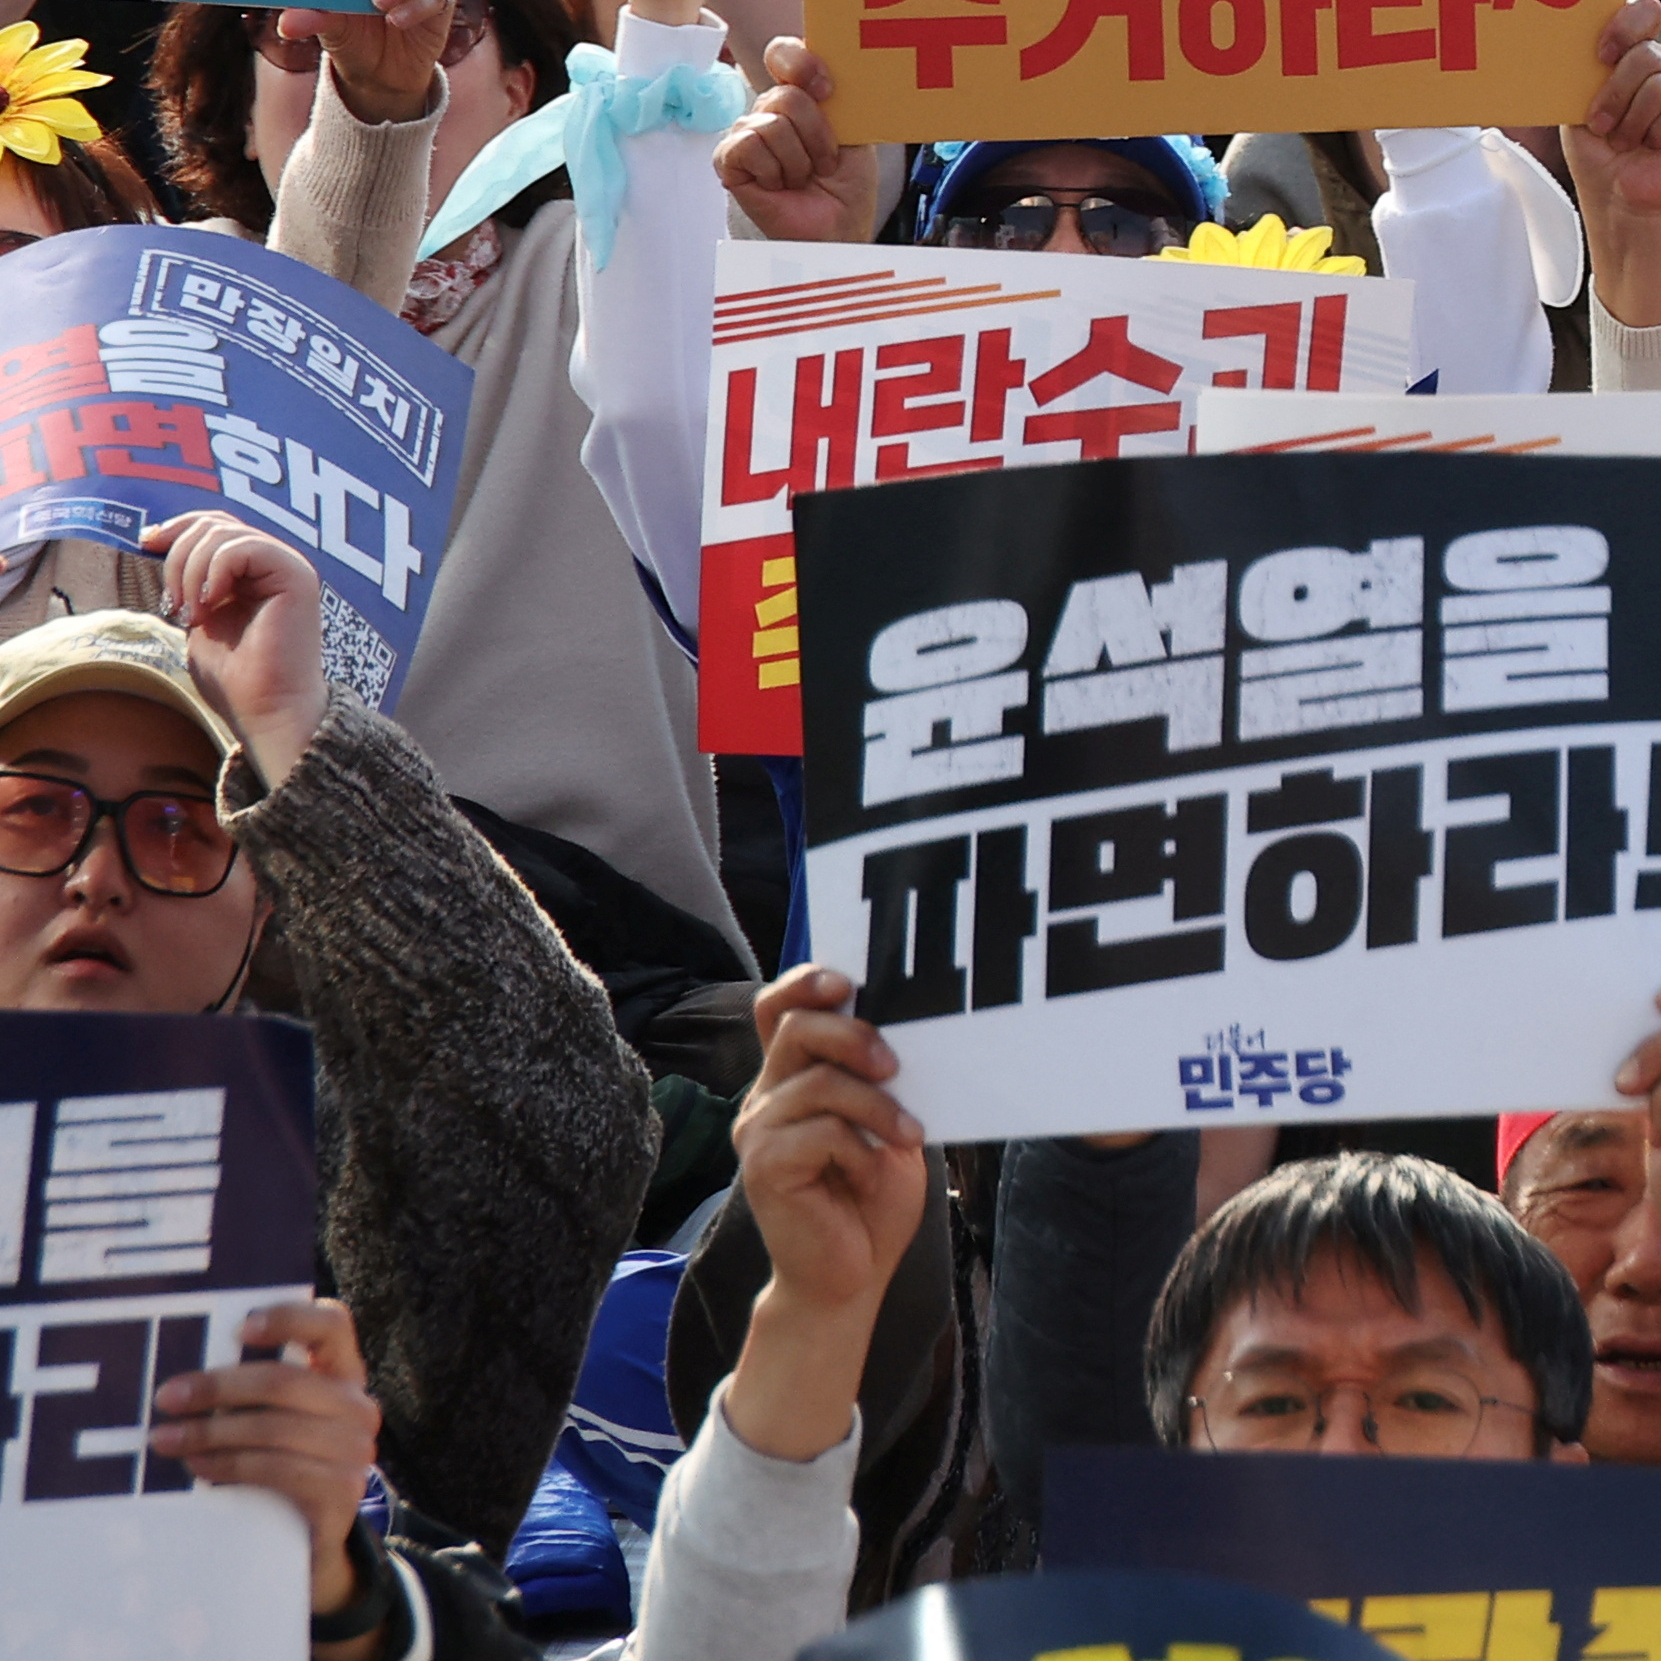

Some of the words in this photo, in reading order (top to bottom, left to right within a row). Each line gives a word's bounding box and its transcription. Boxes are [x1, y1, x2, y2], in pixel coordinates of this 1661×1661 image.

[180, 272, 411, 441] 만장일치
[861, 522, 1612, 810] 윤석열을
[1177, 1047, 1353, 1113] 민주당
